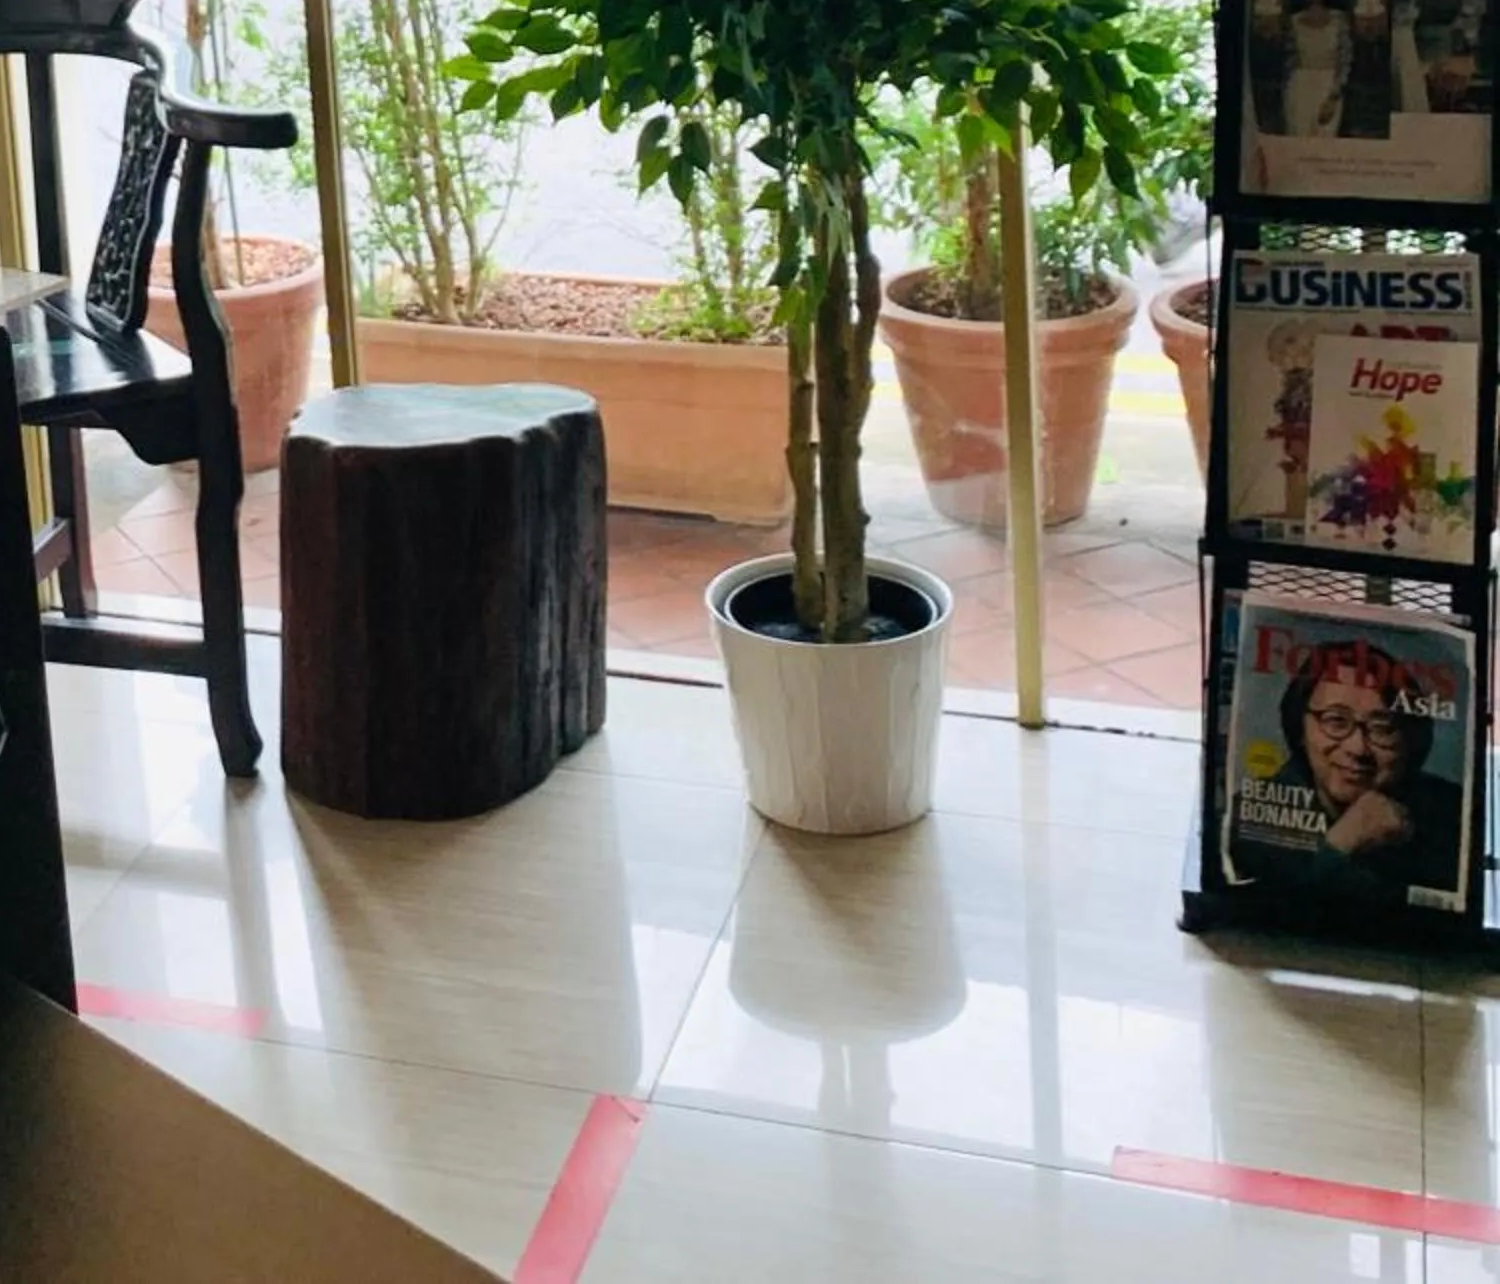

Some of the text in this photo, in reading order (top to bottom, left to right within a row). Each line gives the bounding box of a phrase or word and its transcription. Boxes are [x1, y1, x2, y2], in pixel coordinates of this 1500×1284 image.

[1349, 357, 1442, 402] Hope
[1252, 625, 1459, 696] Forbes
[1389, 688, 1458, 721] Asia
[1241, 778, 1316, 807] BEAUTY
[1239, 800, 1329, 835] BONANZA
